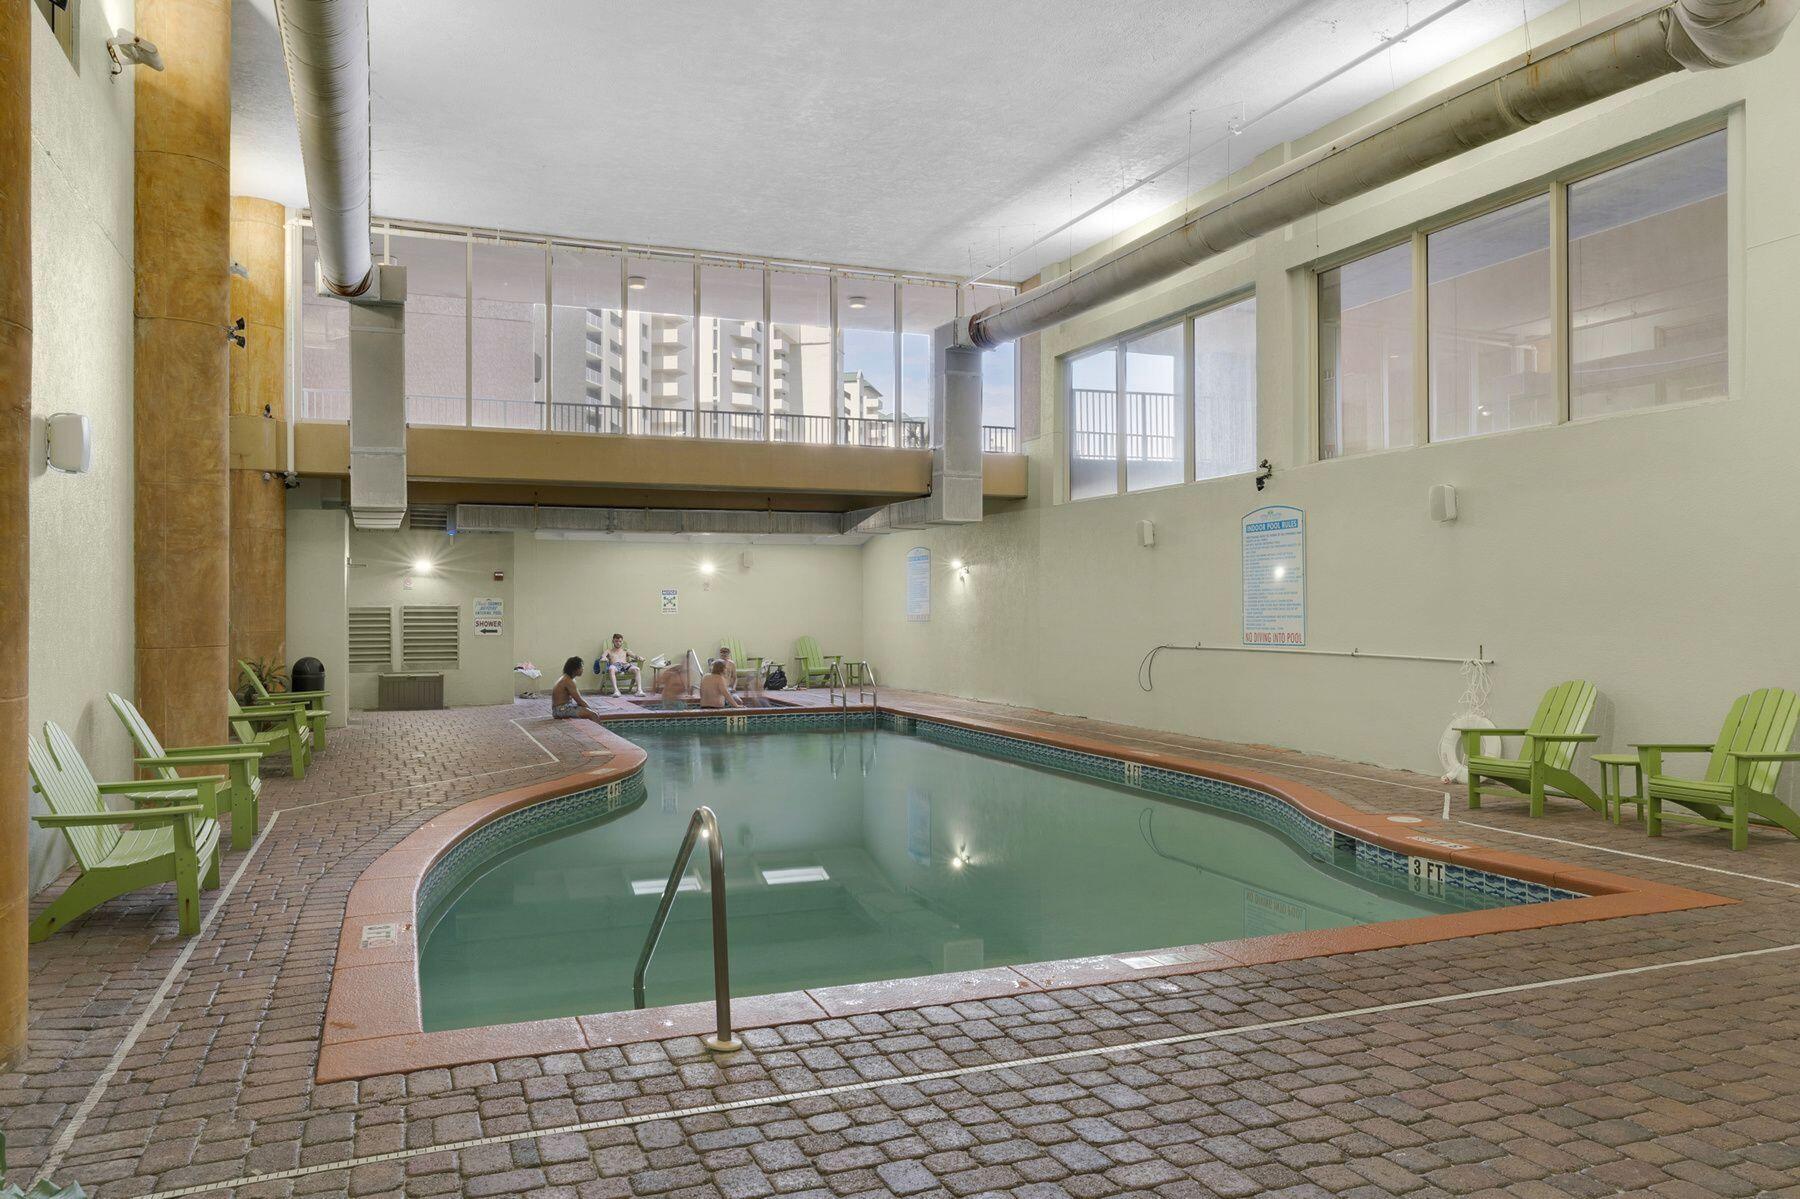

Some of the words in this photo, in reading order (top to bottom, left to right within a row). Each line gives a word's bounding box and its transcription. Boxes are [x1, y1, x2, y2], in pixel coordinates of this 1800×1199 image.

[1246, 523, 1266, 532] INDOOR
[1267, 522, 1280, 531] POOL
[1281, 520, 1298, 529] RULES
[1245, 632, 1253, 643] NO
[1254, 632, 1272, 643] DIVING
[1273, 632, 1286, 644] INTO
[1287, 632, 1302, 644] POOL
[1413, 859, 1421, 876] 3
